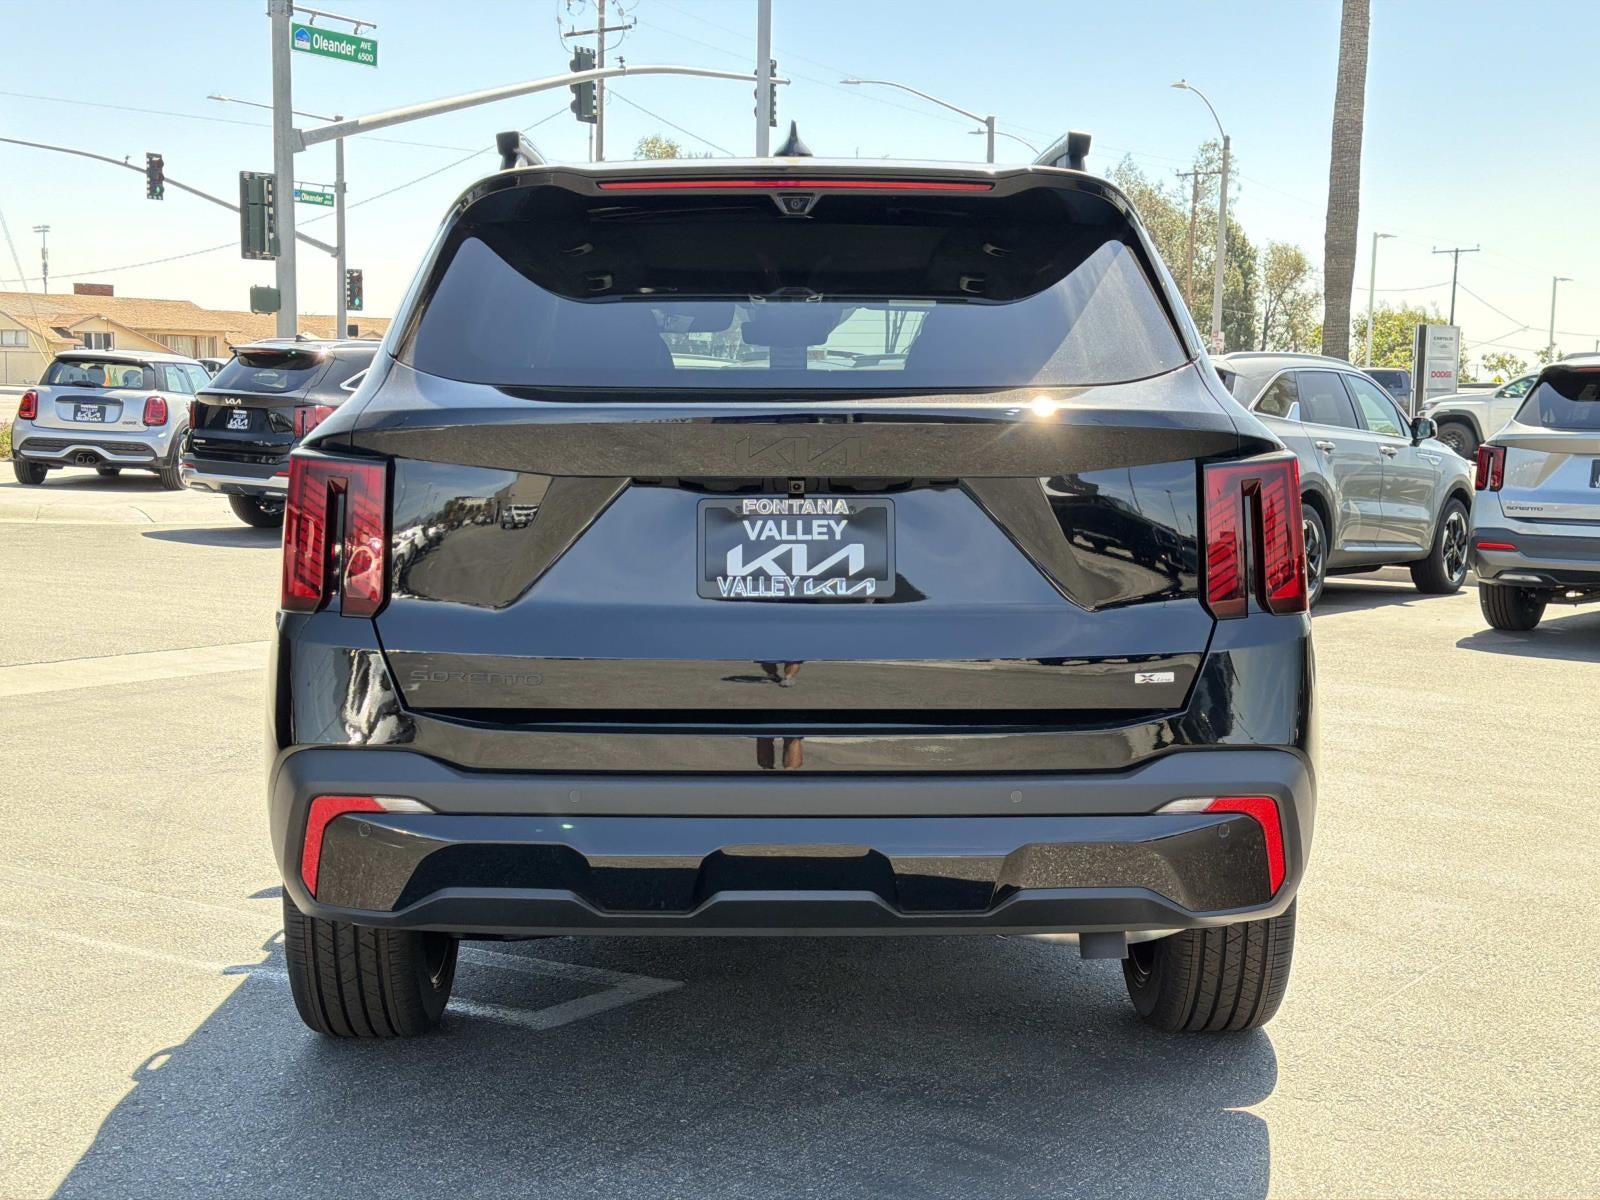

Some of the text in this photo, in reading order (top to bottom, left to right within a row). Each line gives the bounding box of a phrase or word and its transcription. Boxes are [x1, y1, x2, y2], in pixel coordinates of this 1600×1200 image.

[313, 33, 356, 56] Oleander
[360, 41, 372, 51] AVE
[357, 52, 374, 62] 6500
[301, 192, 323, 203] Oleander
[742, 499, 849, 515] FONTANA
[743, 520, 848, 540] VALLEY
[727, 543, 864, 576] KIA
[717, 576, 876, 597] VALLEY KIA
[410, 670, 544, 687] SORENTO
